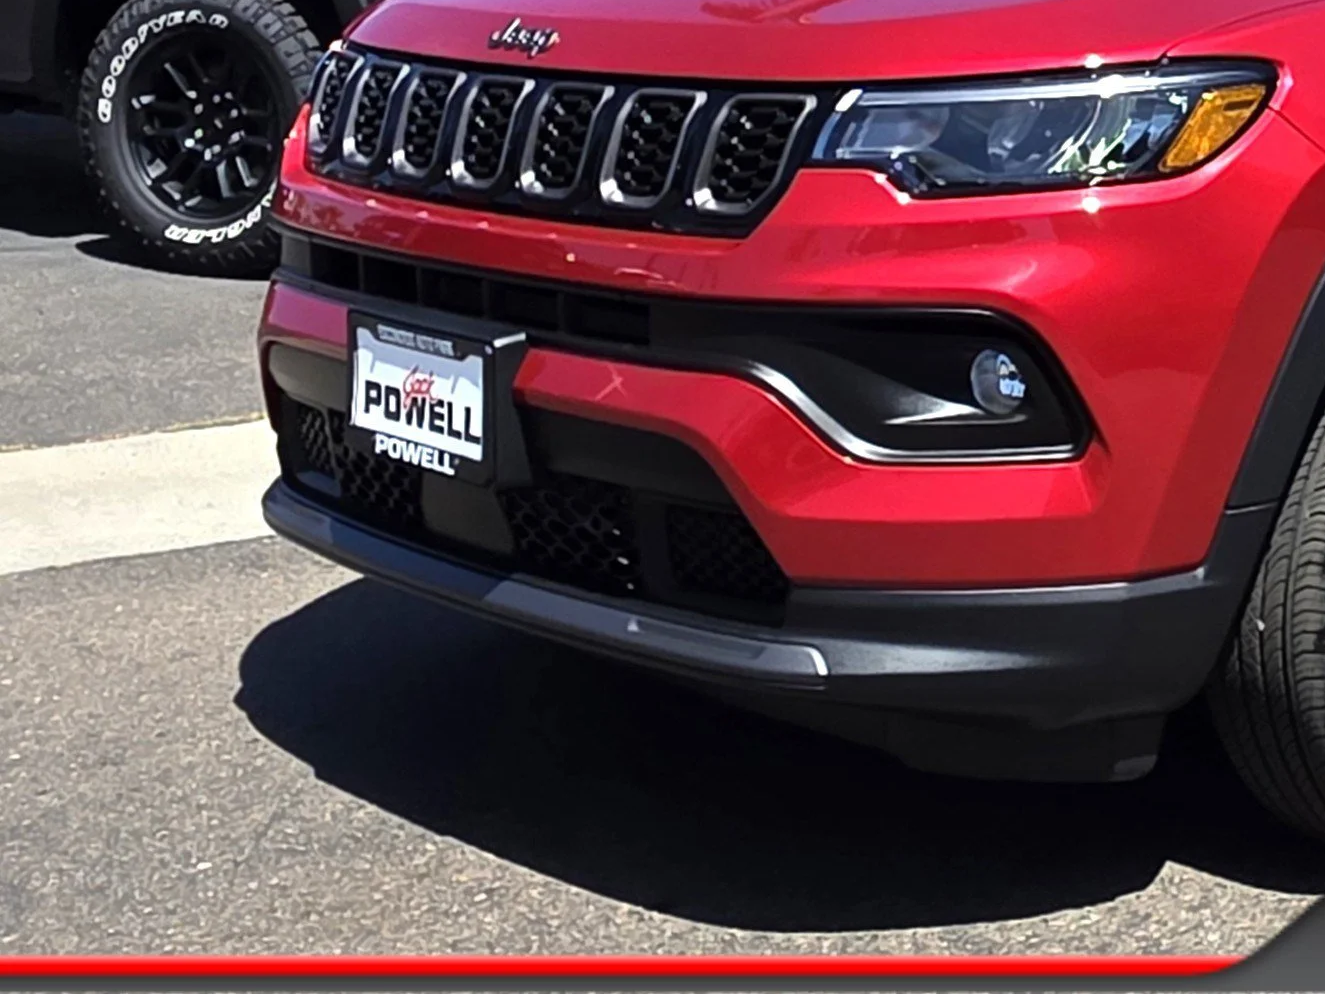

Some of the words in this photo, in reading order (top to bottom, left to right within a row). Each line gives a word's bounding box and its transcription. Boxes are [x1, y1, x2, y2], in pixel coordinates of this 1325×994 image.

[487, 14, 561, 60] Jeep
[97, 9, 230, 124] GOODYEAR
[364, 379, 482, 446] POWELL
[374, 432, 456, 477] POWELL
